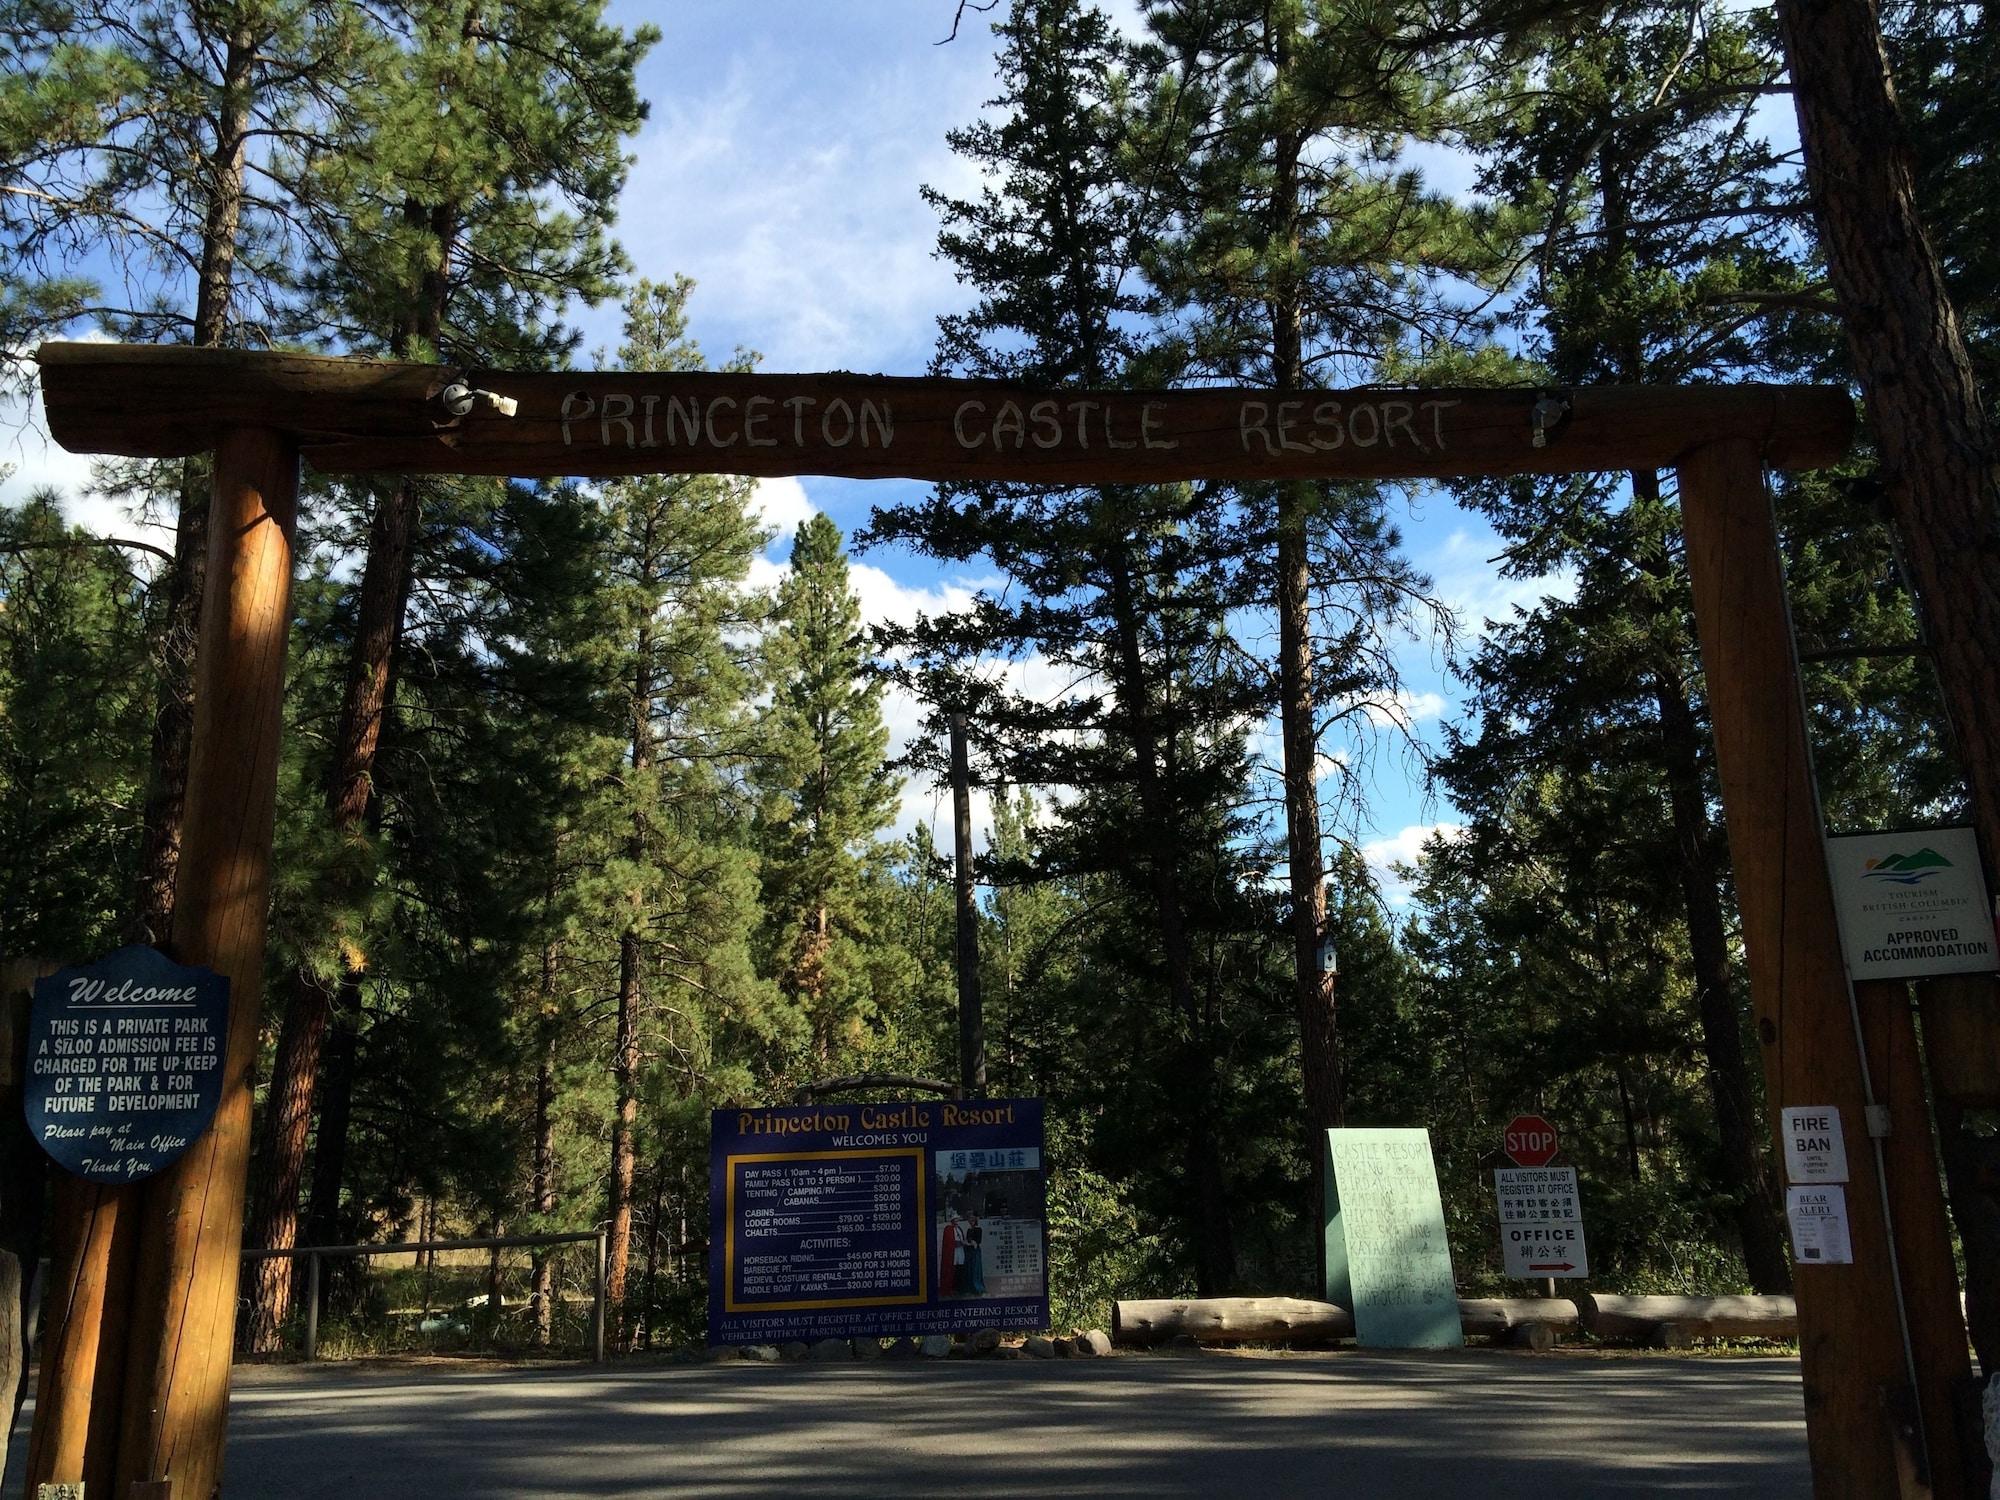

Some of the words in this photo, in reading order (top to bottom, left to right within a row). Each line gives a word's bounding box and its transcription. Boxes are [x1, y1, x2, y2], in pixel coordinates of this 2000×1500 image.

[560, 391, 894, 449] PRINCETON
[954, 400, 1179, 451] CASTLE
[1239, 399, 1461, 456] RESORT
[1888, 889, 1937, 899] TOURISM
[1863, 900, 1906, 912] BRITISH
[1911, 898, 1967, 909] COLUMBIA
[1887, 928, 1958, 944] APPROVED
[1864, 942, 1988, 962] ACCOMMODATION
[69, 978, 196, 1002] Welcome
[50, 1020, 79, 1035] THIS
[85, 1020, 97, 1035] IS
[103, 1020, 112, 1034] A
[117, 1019, 169, 1034] PRIVATE
[175, 1018, 208, 1033] PARK
[39, 1040, 48, 1054] A
[98, 1037, 169, 1054] ADMISSION
[175, 1037, 198, 1052] FEE
[204, 1036, 215, 1052] IS
[34, 1058, 96, 1074] CHARGED
[102, 1058, 127, 1073] FOR
[134, 1057, 157, 1072] THE
[55, 1078, 73, 1093] OF
[78, 1077, 102, 1092] THE
[107, 1076, 142, 1092] PARK
[151, 1075, 158, 1090] &
[168, 1075, 192, 1090] FOR
[45, 1096, 95, 1112] FUTURE
[109, 1094, 200, 1111] DEVELOPMENT
[738, 1111, 850, 1137] Princeton
[861, 1105, 930, 1130] Castle
[942, 1104, 1015, 1126] Resort
[1793, 1118, 1830, 1131] FIRE
[44, 1124, 85, 1140] Please
[89, 1125, 113, 1139] pay
[118, 1123, 132, 1134] at
[832, 1134, 898, 1146] WELCOMES
[902, 1132, 927, 1144] YOU
[110, 1139, 145, 1152] Main
[150, 1135, 186, 1152] Office
[1508, 1133, 1552, 1151] STOP
[1796, 1138, 1830, 1152] BAN
[1335, 1142, 1383, 1159] CASTLE
[1384, 1143, 1428, 1160] RESORT
[82, 1159, 120, 1174] Thank
[745, 1170, 759, 1179] DAY
[762, 1169, 781, 1178] PASS
[879, 1165, 900, 1173] $7.00
[745, 1180, 769, 1189] FAMILY
[772, 1179, 790, 1187] PASS
[799, 1178, 804, 1186] 3
[806, 1177, 816, 1186] TO
[819, 1177, 823, 1185] 5
[826, 1175, 855, 1184] PERSON
[875, 1174, 900, 1182] $20.00
[1502, 1173, 1514, 1183] ALL
[1516, 1172, 1548, 1182] VISITORS
[1550, 1171, 1569, 1181] MUST
[745, 1190, 778, 1198] TENTING
[874, 1184, 900, 1192] $30.00
[1500, 1185, 1535, 1195] REGISTER
[1537, 1185, 1545, 1194] AT
[1548, 1184, 1573, 1194] OFFICE
[784, 1197, 819, 1206] CABANAS
[874, 1194, 900, 1202] $50.00
[1800, 1195, 1826, 1203] BEAR
[745, 1209, 774, 1218] CABINS
[1799, 1206, 1831, 1214] ALERT
[745, 1219, 770, 1228] LODGE
[773, 1217, 800, 1226] ROOMS
[745, 1229, 778, 1237] CHALETS
[1511, 1230, 1575, 1241] OFFICE
[800, 1238, 851, 1249] ACTIVITIES:
[744, 1256, 787, 1265] HORSEBACK
[791, 1255, 814, 1263] RIDING
[891, 1250, 910, 1258] HOUR
[744, 1266, 779, 1275] BARBECUE
[782, 1265, 792, 1273] PIT
[865, 1261, 878, 1269] FOR
[777, 1274, 810, 1283] COSTUME
[813, 1272, 841, 1281] RENTALS
[876, 1270, 889, 1278] PER
[892, 1269, 910, 1277] HOUR
[744, 1285, 770, 1294] PADDLE
[773, 1284, 791, 1293] BOAT
[801, 1283, 827, 1291] KAYAKS
[875, 1280, 888, 1288] PER
[891, 1279, 910, 1287] HOUR
[721, 1321, 739, 1330] ALL
[742, 1317, 784, 1329] VISITORS
[788, 1316, 814, 1326] MUST
[818, 1314, 861, 1324] REGISTER
[865, 1313, 876, 1322] AT
[880, 1311, 912, 1321] OFFICE
[916, 1309, 950, 1319] BEFORE
[954, 1307, 1001, 1318] ENTERING
[1005, 1305, 1039, 1315] RESORT
[721, 1330, 762, 1341] VEHICLES
[765, 1328, 806, 1338] WITHOUT
[810, 1327, 845, 1336] PARKING
[920, 1320, 949, 1330] TOWED
[952, 1320, 961, 1328] AT
[965, 1319, 1000, 1328] OWNERS
[1003, 1317, 1038, 1326] EXPENSE
